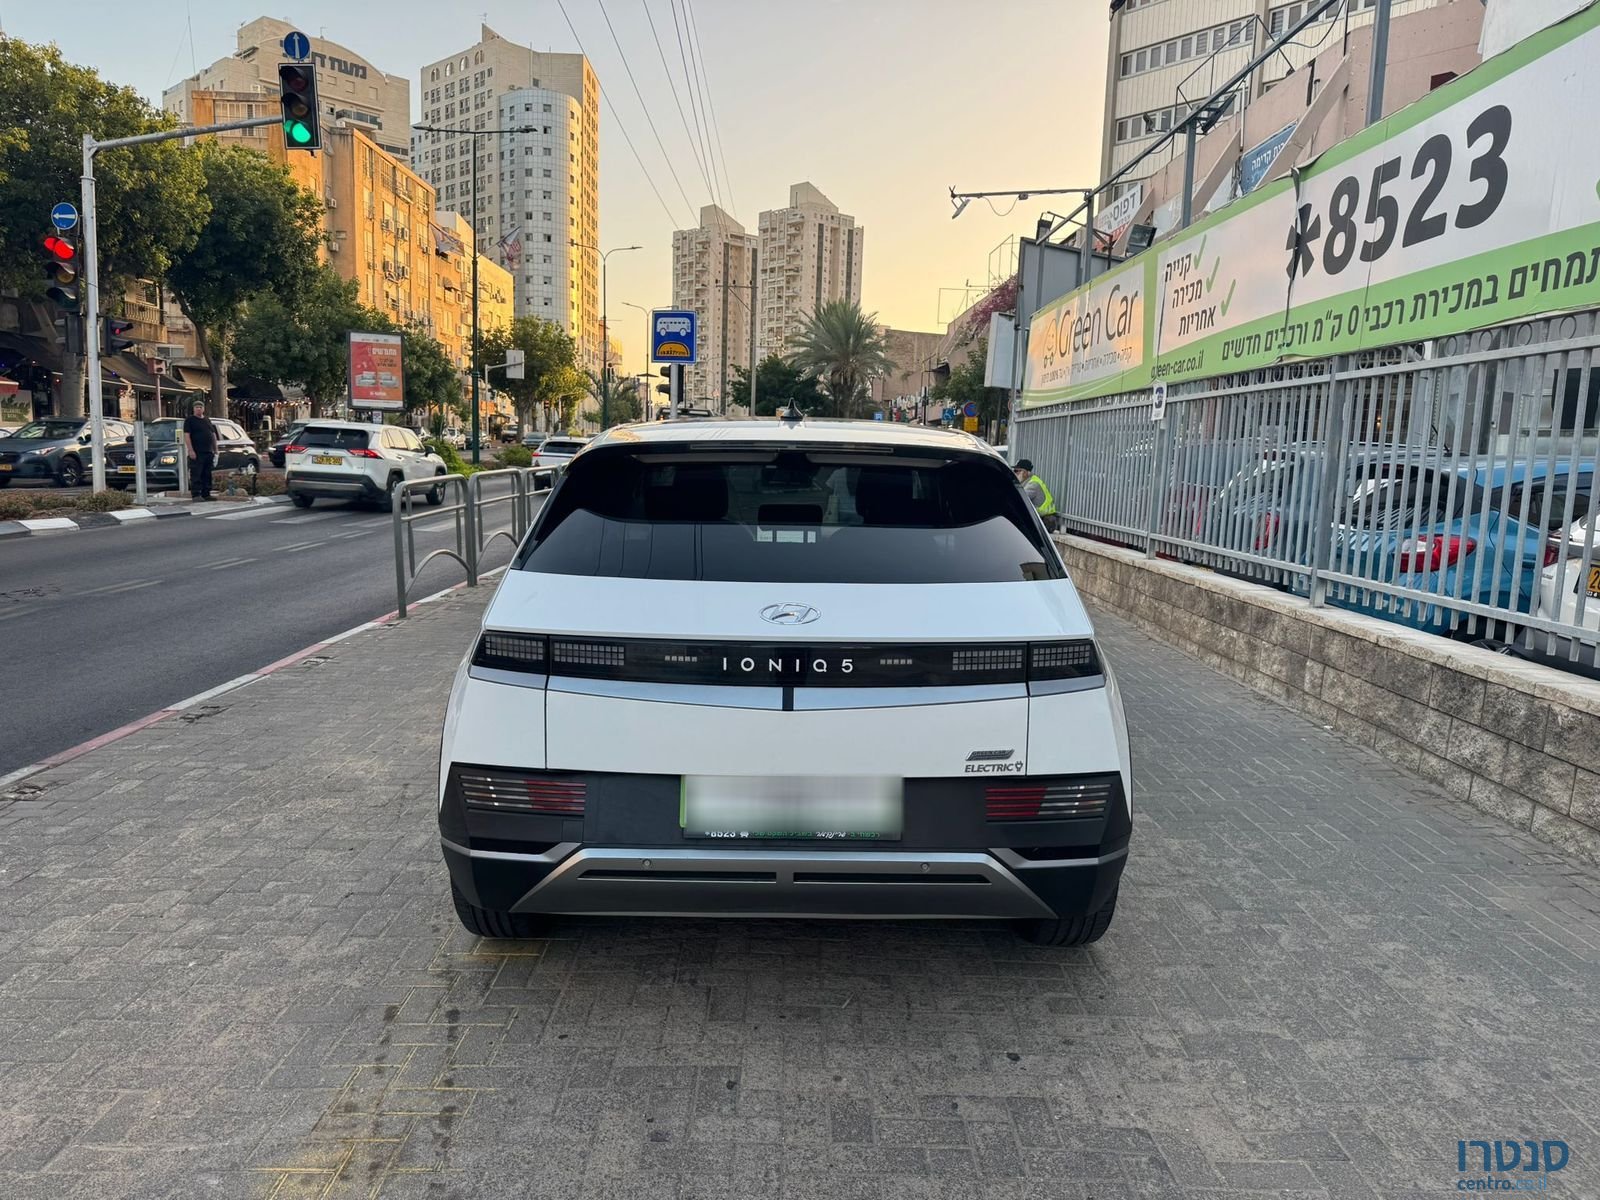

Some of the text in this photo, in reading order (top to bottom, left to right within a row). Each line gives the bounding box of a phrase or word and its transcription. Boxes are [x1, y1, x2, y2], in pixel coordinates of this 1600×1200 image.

[1113, 192, 1136, 221] דפוס
[1165, 253, 1192, 282] קנייה
[1172, 279, 1203, 309] מכירה
[1409, 274, 1499, 323] במכירת
[1058, 284, 1138, 358] Green Car
[1178, 305, 1217, 337] אחריות
[1364, 298, 1405, 331] רכבי
[1222, 333, 1261, 361] חדשים
[1264, 322, 1309, 352] ורכבים
[723, 656, 854, 673] IONIQ 5
[964, 763, 1014, 773] ELECTRIC
